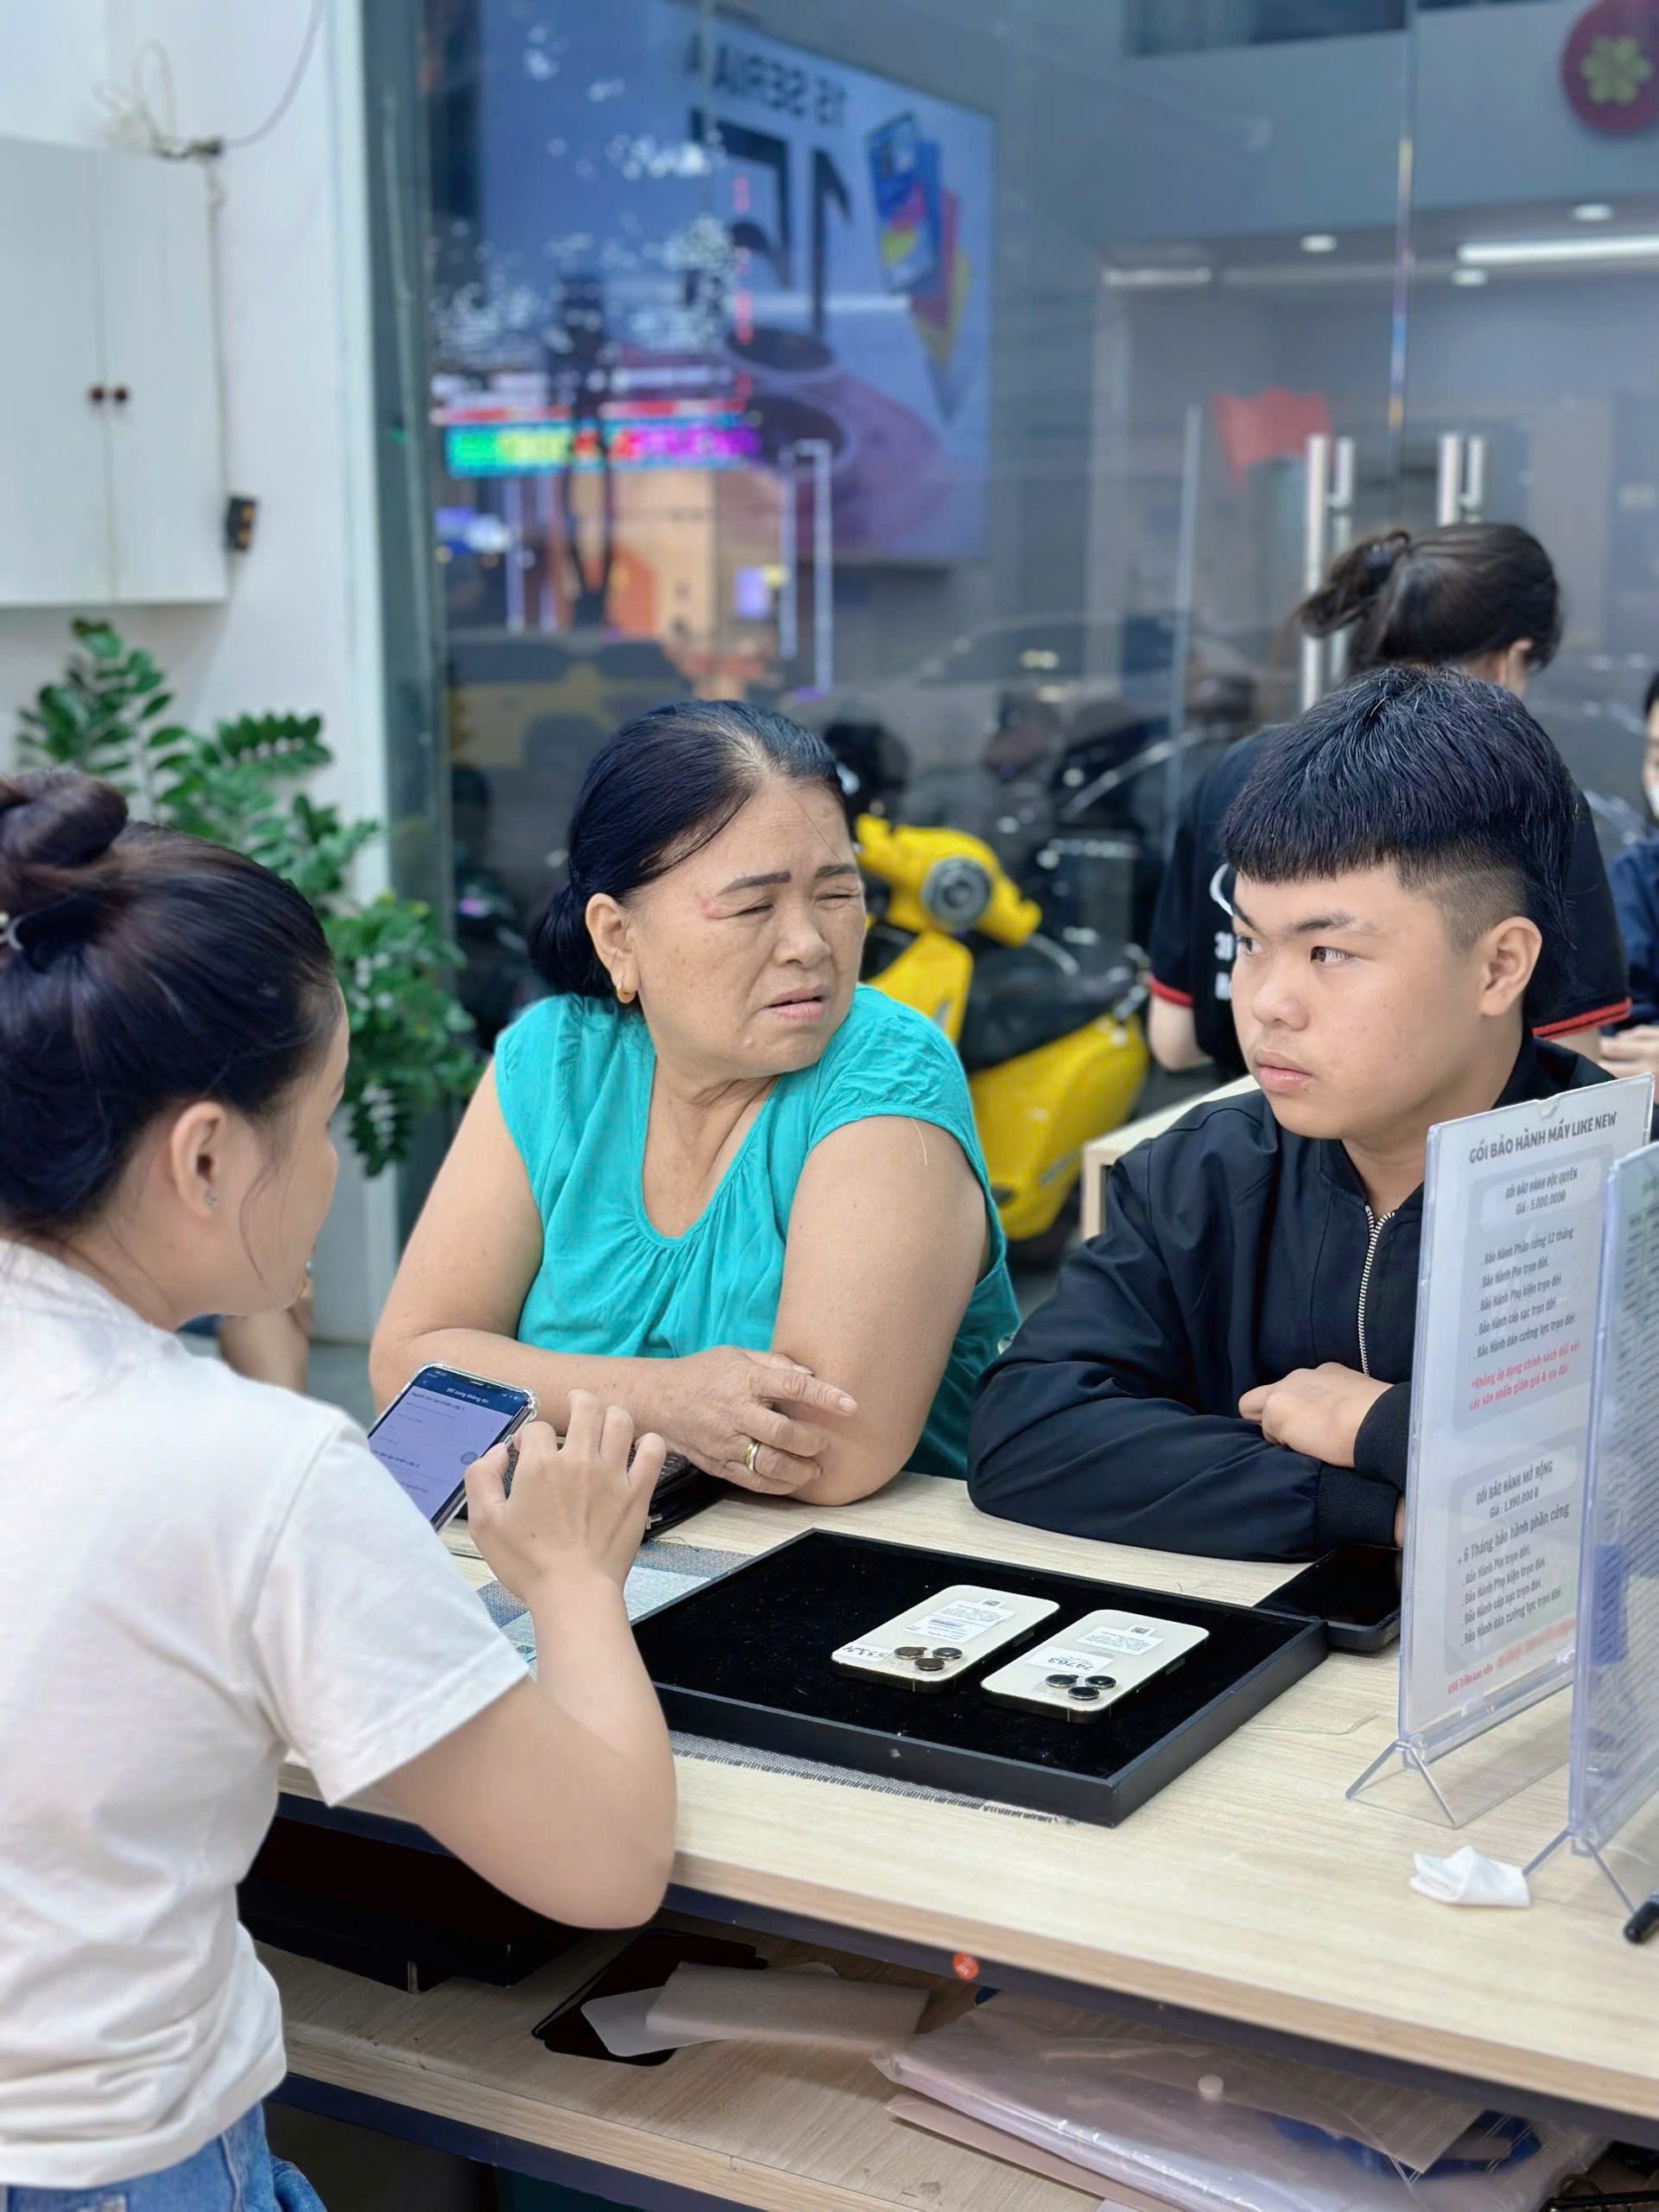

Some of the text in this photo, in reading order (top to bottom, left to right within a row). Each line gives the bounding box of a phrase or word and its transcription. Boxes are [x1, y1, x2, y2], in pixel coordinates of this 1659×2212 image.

[1469, 1110, 1618, 1164] GÓI BẢO HÀNH MÁY LIKE NEW
[1529, 1175, 1546, 1192] HÀNH
[1548, 1231, 1555, 1244] 12
[1511, 1266, 1522, 1279] Pin
[1476, 1486, 1487, 1505] GÓI
[1489, 1481, 1503, 1500] BẢO
[1503, 1475, 1522, 1492] HÀNH
[1471, 1539, 1494, 1559] Tháng
[1495, 1529, 1509, 1546] bảo
[1510, 1521, 1529, 1539] hành
